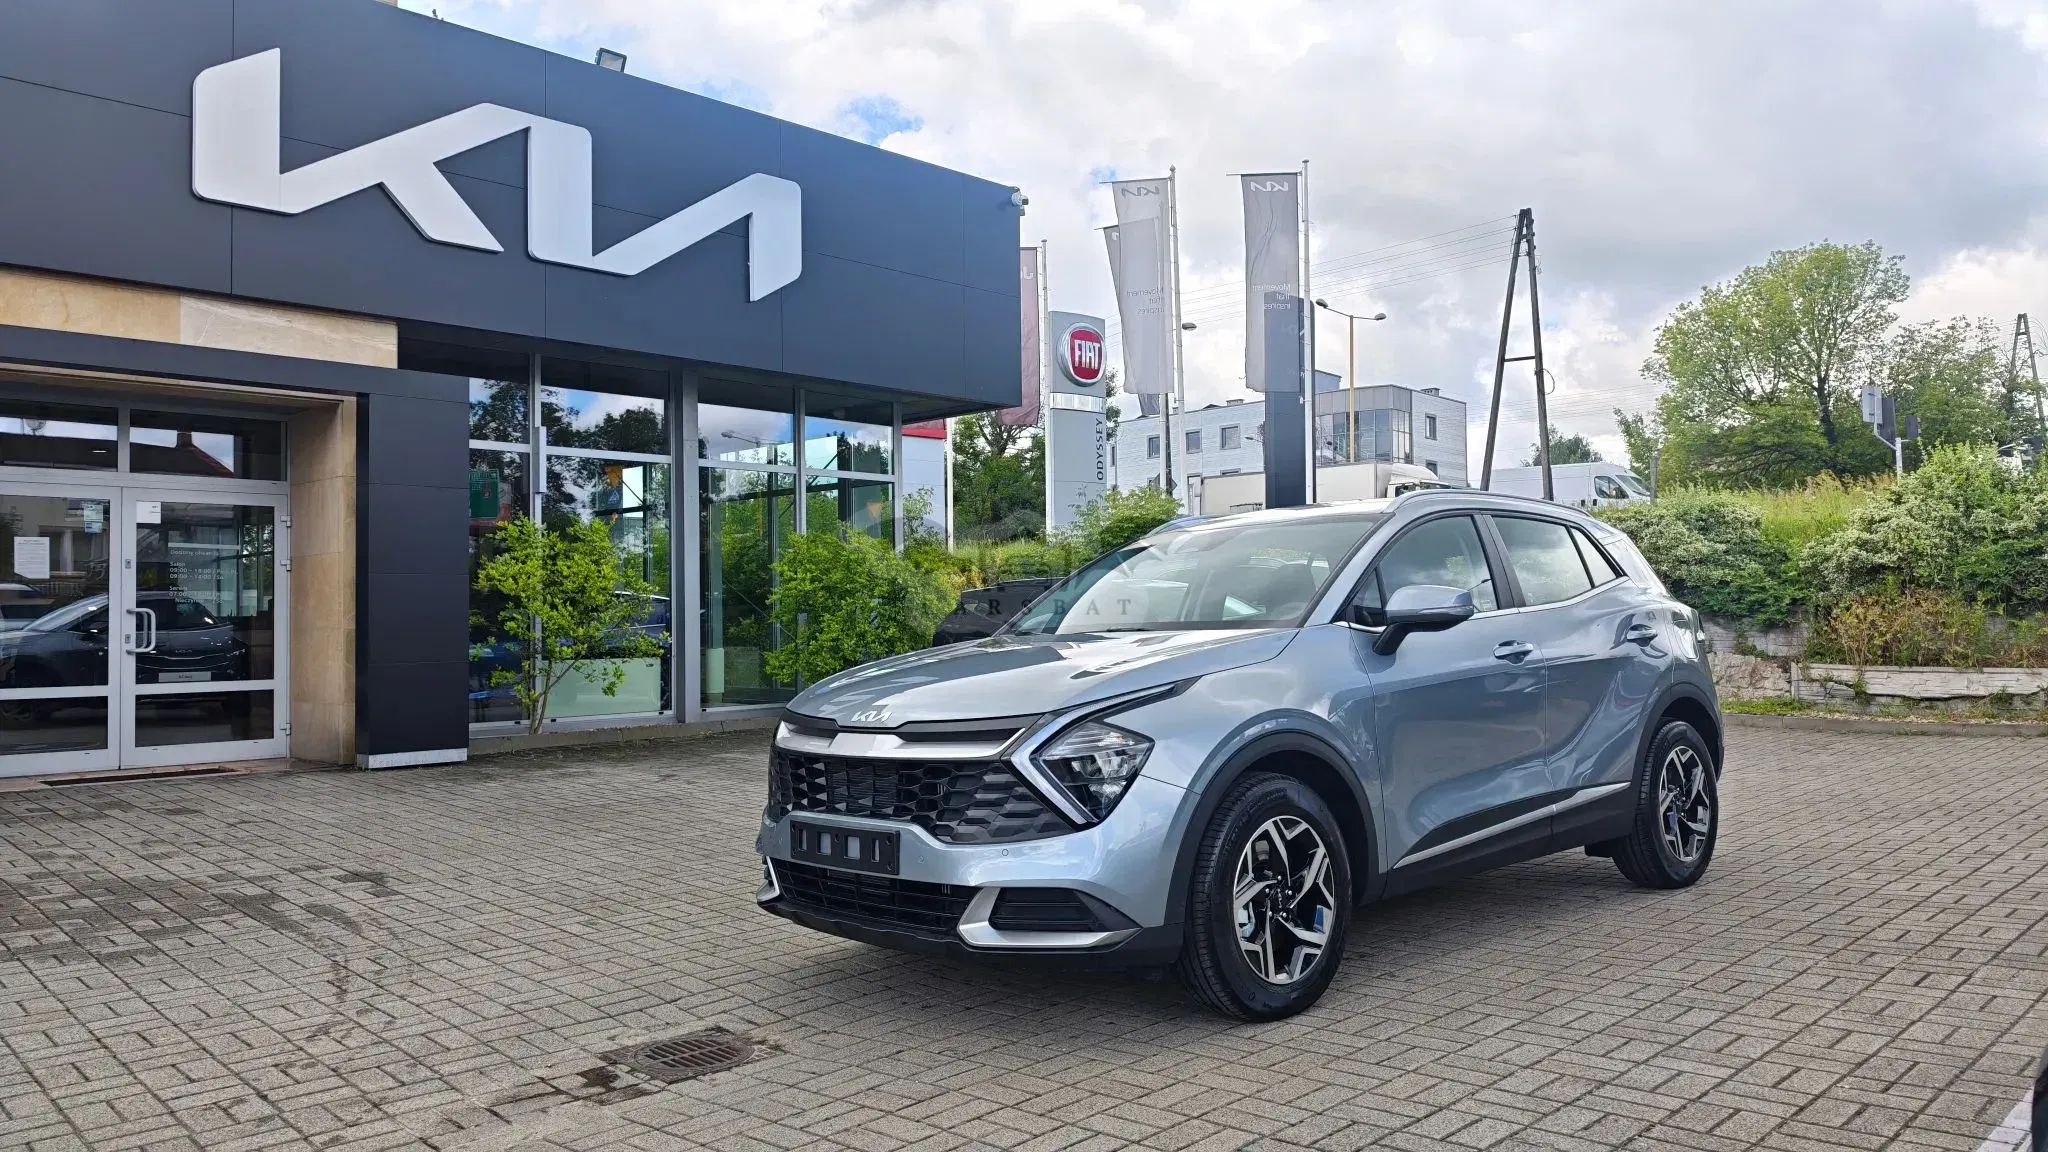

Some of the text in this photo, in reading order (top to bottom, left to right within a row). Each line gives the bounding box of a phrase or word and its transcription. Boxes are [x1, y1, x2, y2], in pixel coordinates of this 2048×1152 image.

[192, 47, 802, 302] KIA
[1074, 339, 1101, 370] FIAT
[1095, 417, 1104, 481] ODYSSEY
[851, 710, 893, 722] KIA
